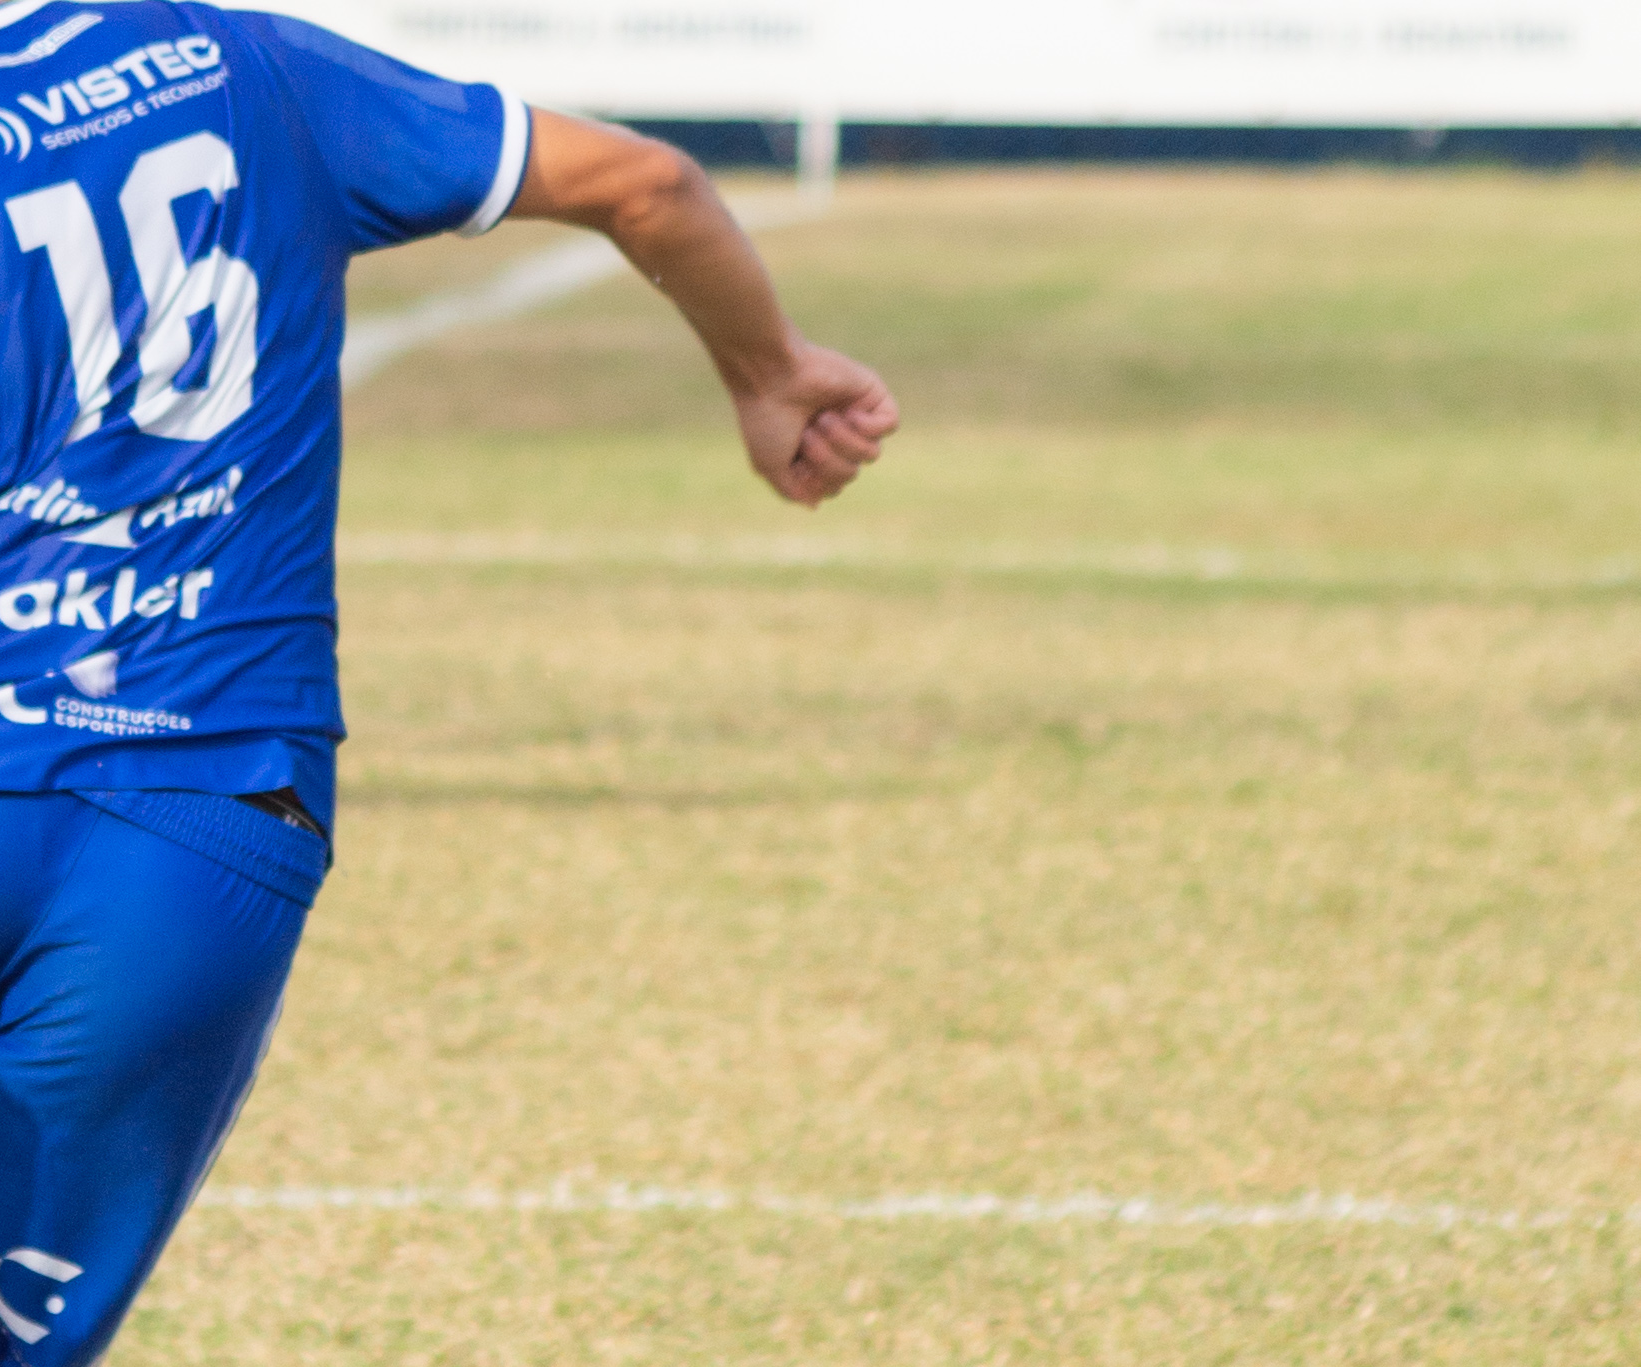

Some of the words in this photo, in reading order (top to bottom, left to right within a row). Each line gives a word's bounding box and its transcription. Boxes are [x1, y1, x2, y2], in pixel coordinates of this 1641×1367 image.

[18, 34, 221, 126] VISTEC
[40, 107, 134, 151] SERVIÇOS
[4, 131, 257, 445] 16
[54, 695, 193, 731] CONSTRUÇÕES
